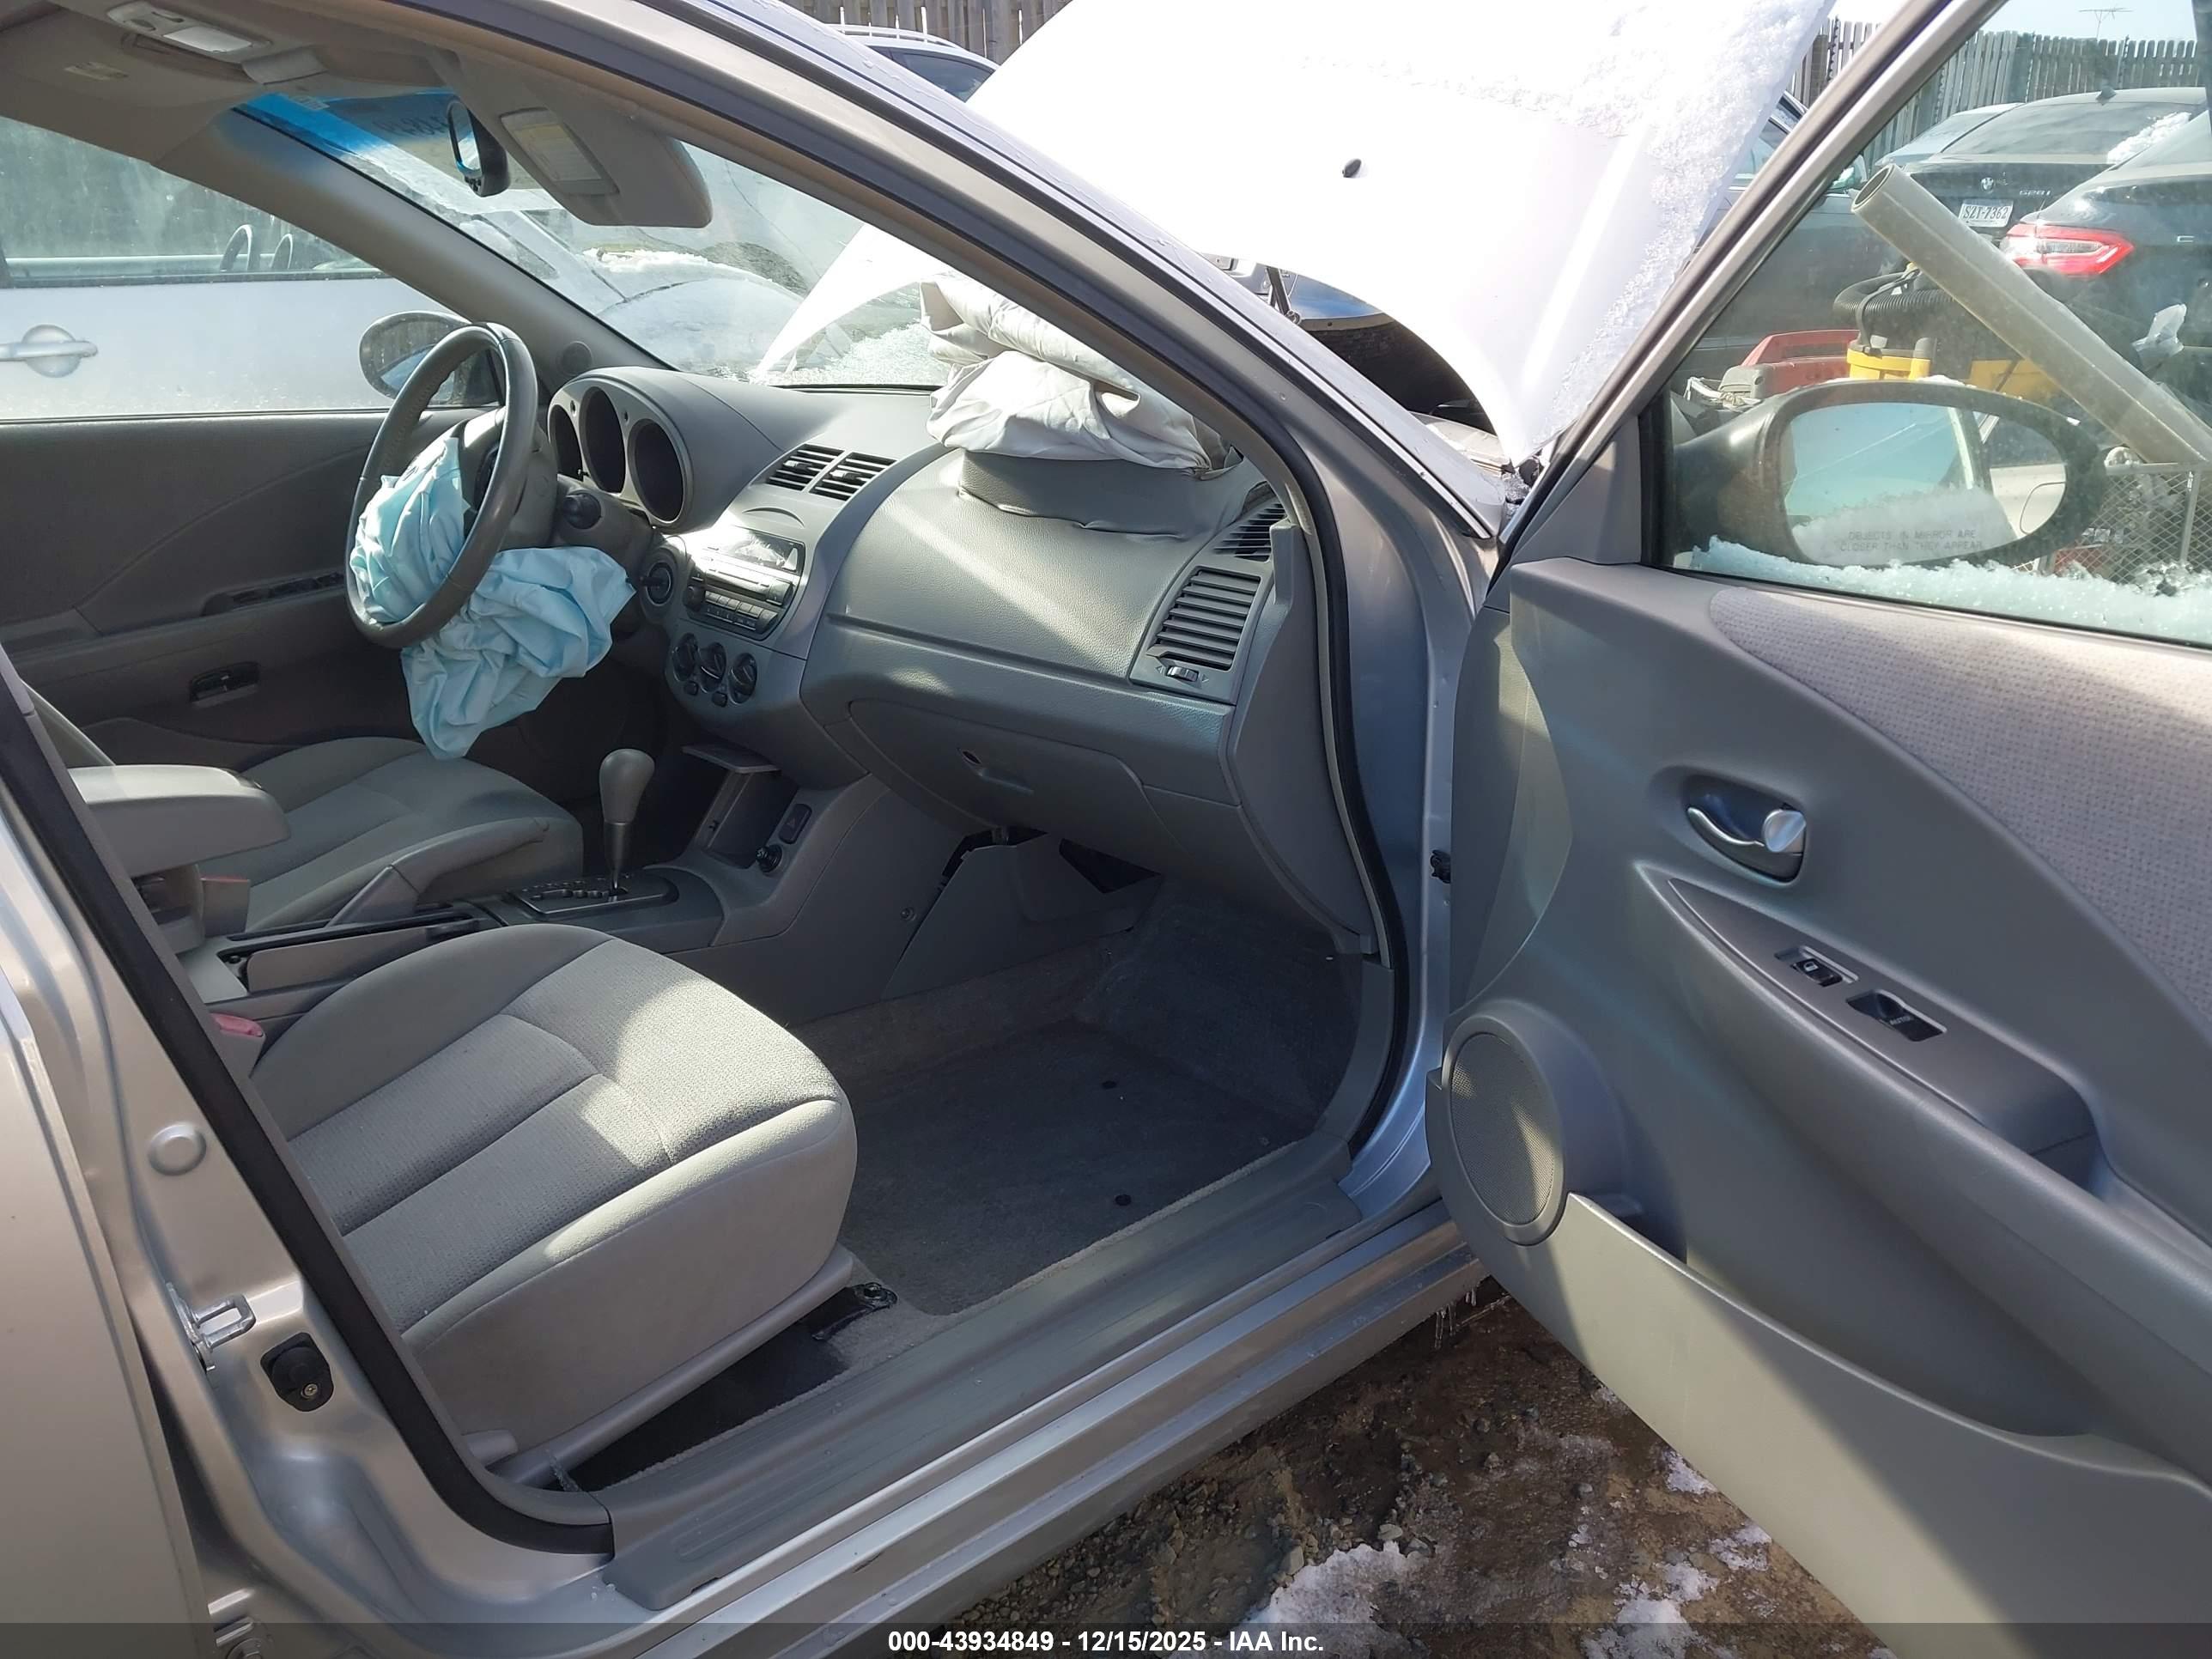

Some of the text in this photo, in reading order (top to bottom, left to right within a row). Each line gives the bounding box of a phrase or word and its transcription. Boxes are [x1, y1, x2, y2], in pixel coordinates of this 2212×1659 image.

[1848, 529, 1977, 540] OBJECTS IN MIRROR ARE
[1839, 540, 1984, 551] CLOSER THAN THEY APPEAR
